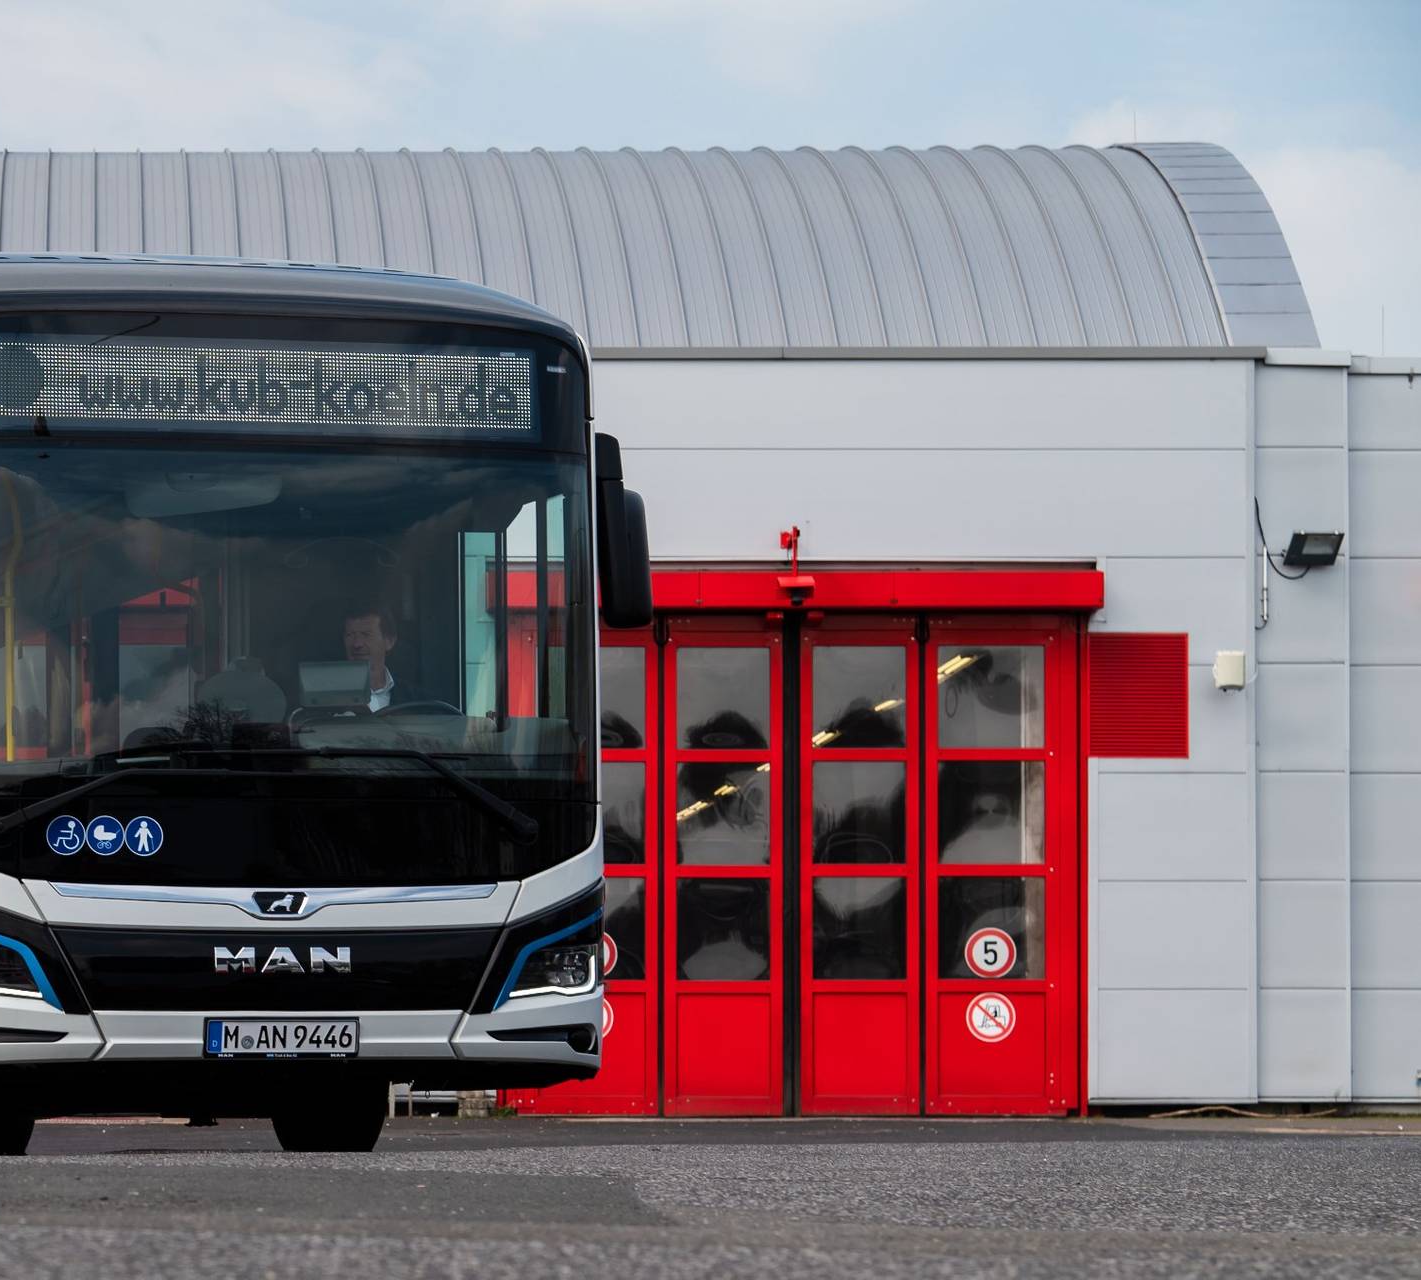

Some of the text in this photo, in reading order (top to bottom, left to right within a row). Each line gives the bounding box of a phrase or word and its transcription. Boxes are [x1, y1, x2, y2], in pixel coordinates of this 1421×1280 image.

[78, 354, 519, 423] www.kvb-koeln.de
[214, 946, 352, 973] MAN
[983, 941, 998, 965] 5
[224, 1025, 239, 1049] M
[256, 1025, 287, 1049] AN
[294, 1025, 353, 1049] 9446
